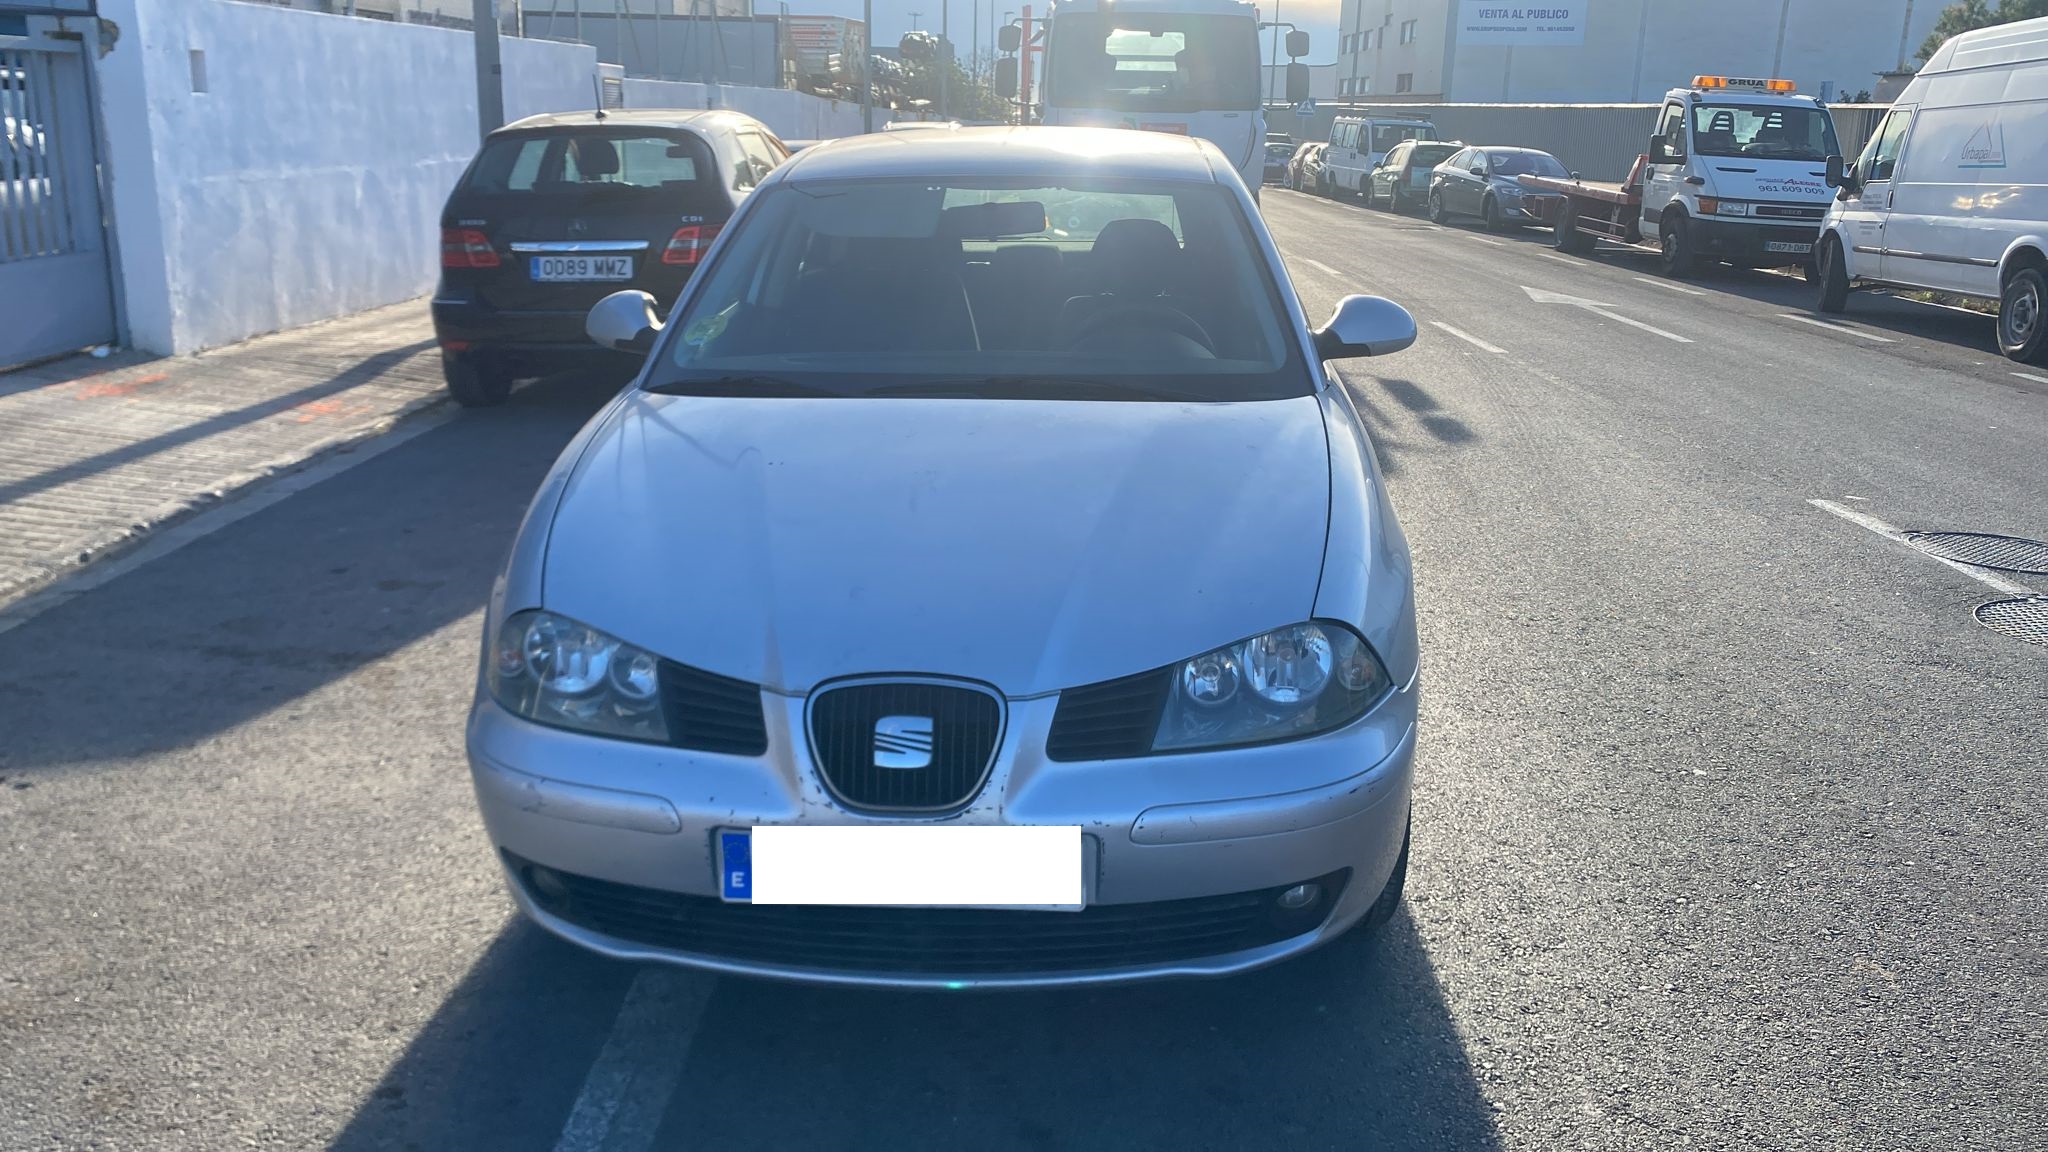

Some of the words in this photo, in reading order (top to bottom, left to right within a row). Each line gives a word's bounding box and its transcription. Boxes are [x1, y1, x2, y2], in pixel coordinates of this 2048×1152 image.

[1479, 9, 1509, 19] VENTA
[1511, 9, 1525, 19] AL
[1527, 9, 1568, 19] PUBLICO
[1781, 185, 1802, 193] 609
[1804, 187, 1825, 195] 009
[543, 259, 588, 276] 0089
[594, 259, 627, 276] MMZ
[731, 871, 745, 888] E
